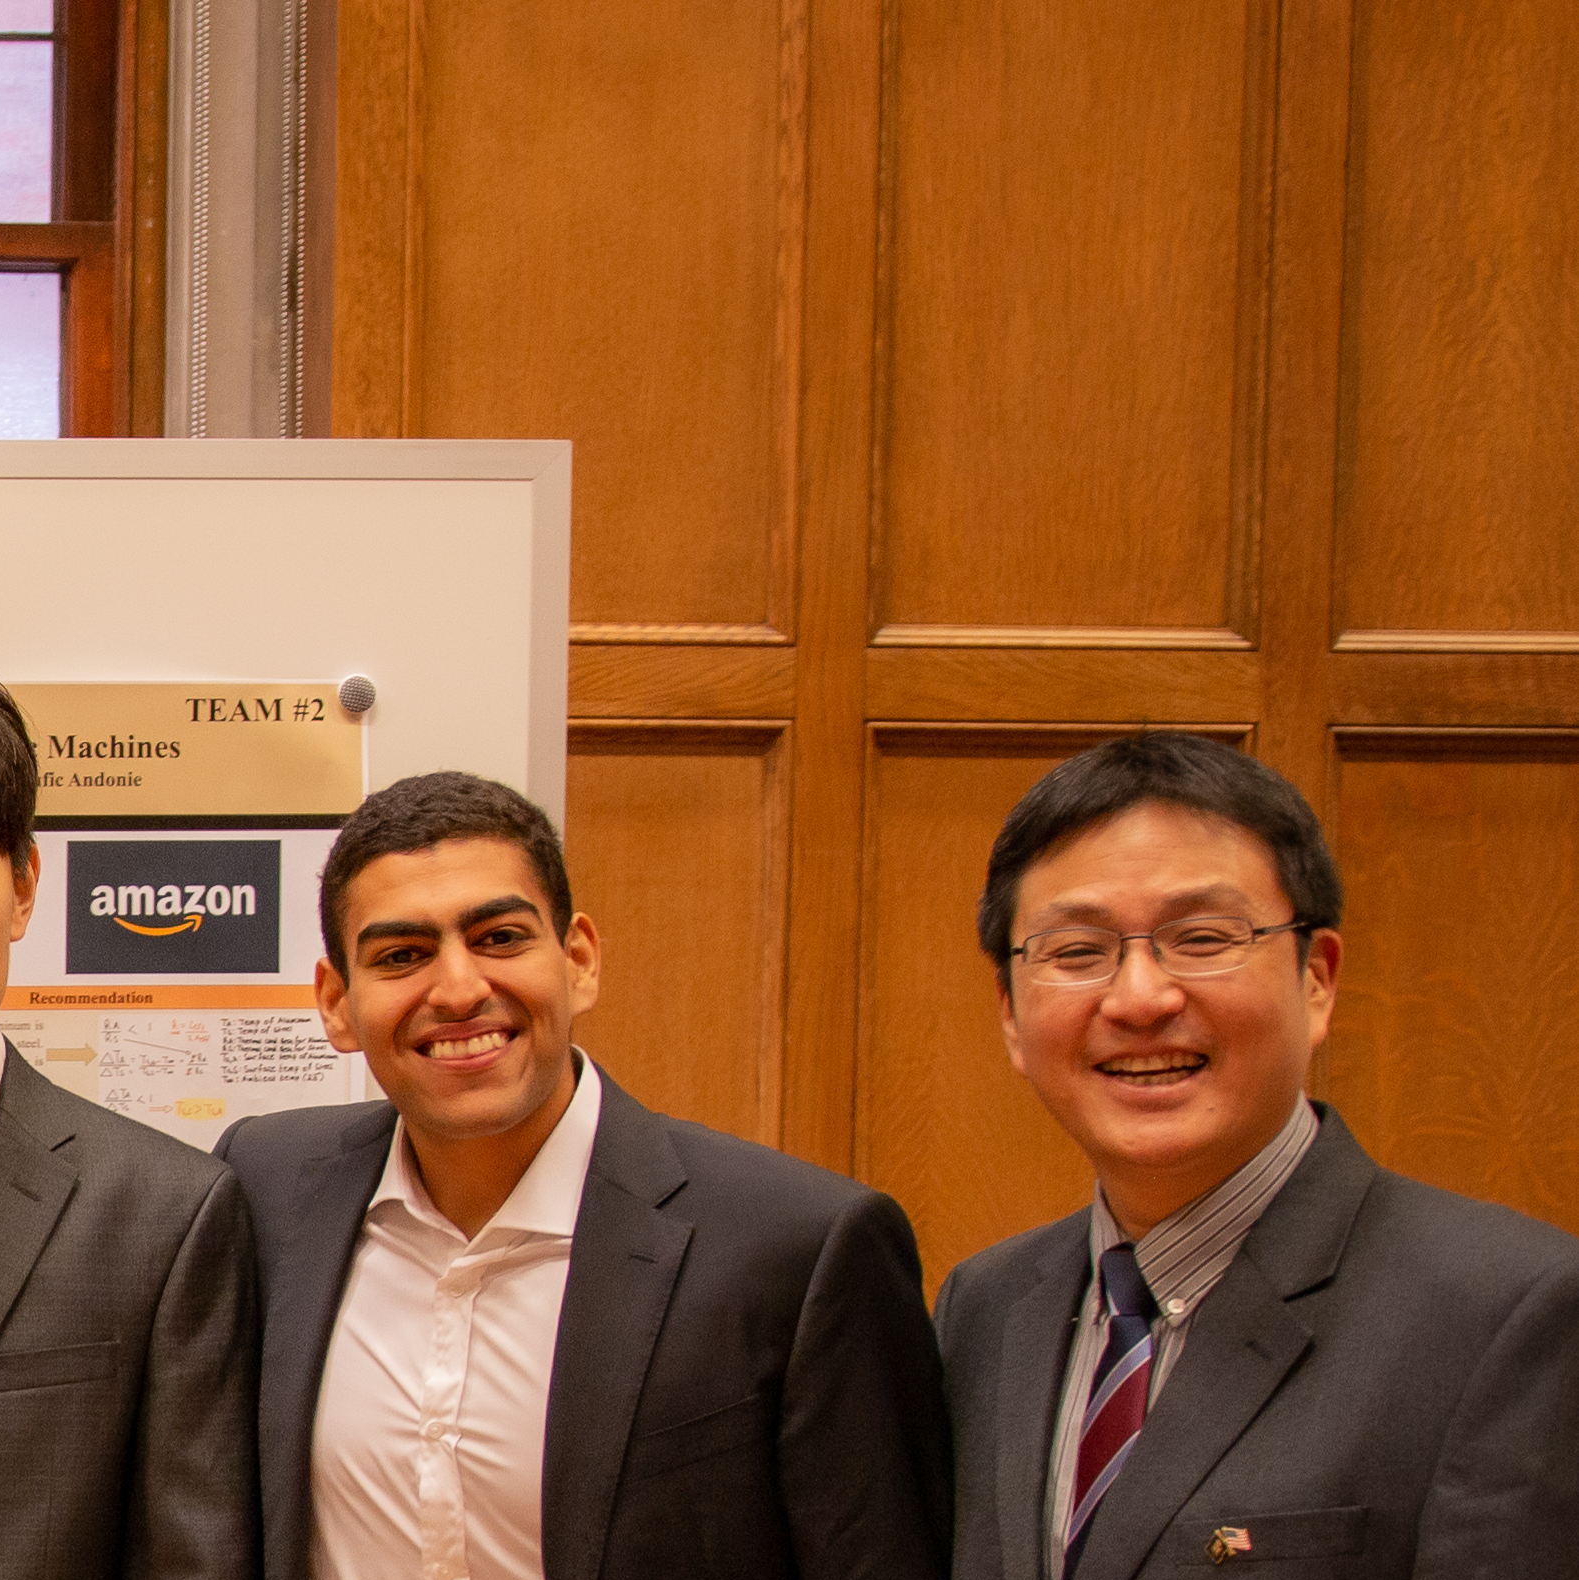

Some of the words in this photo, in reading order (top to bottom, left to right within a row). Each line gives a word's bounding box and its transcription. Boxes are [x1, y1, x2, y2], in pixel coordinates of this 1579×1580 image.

[186, 698, 282, 721] TEAM
[293, 698, 324, 721] #2
[48, 735, 180, 759] Machines
[68, 772, 142, 788] Andonie
[90, 884, 257, 916] amazon
[30, 991, 153, 1004] Recommendation
